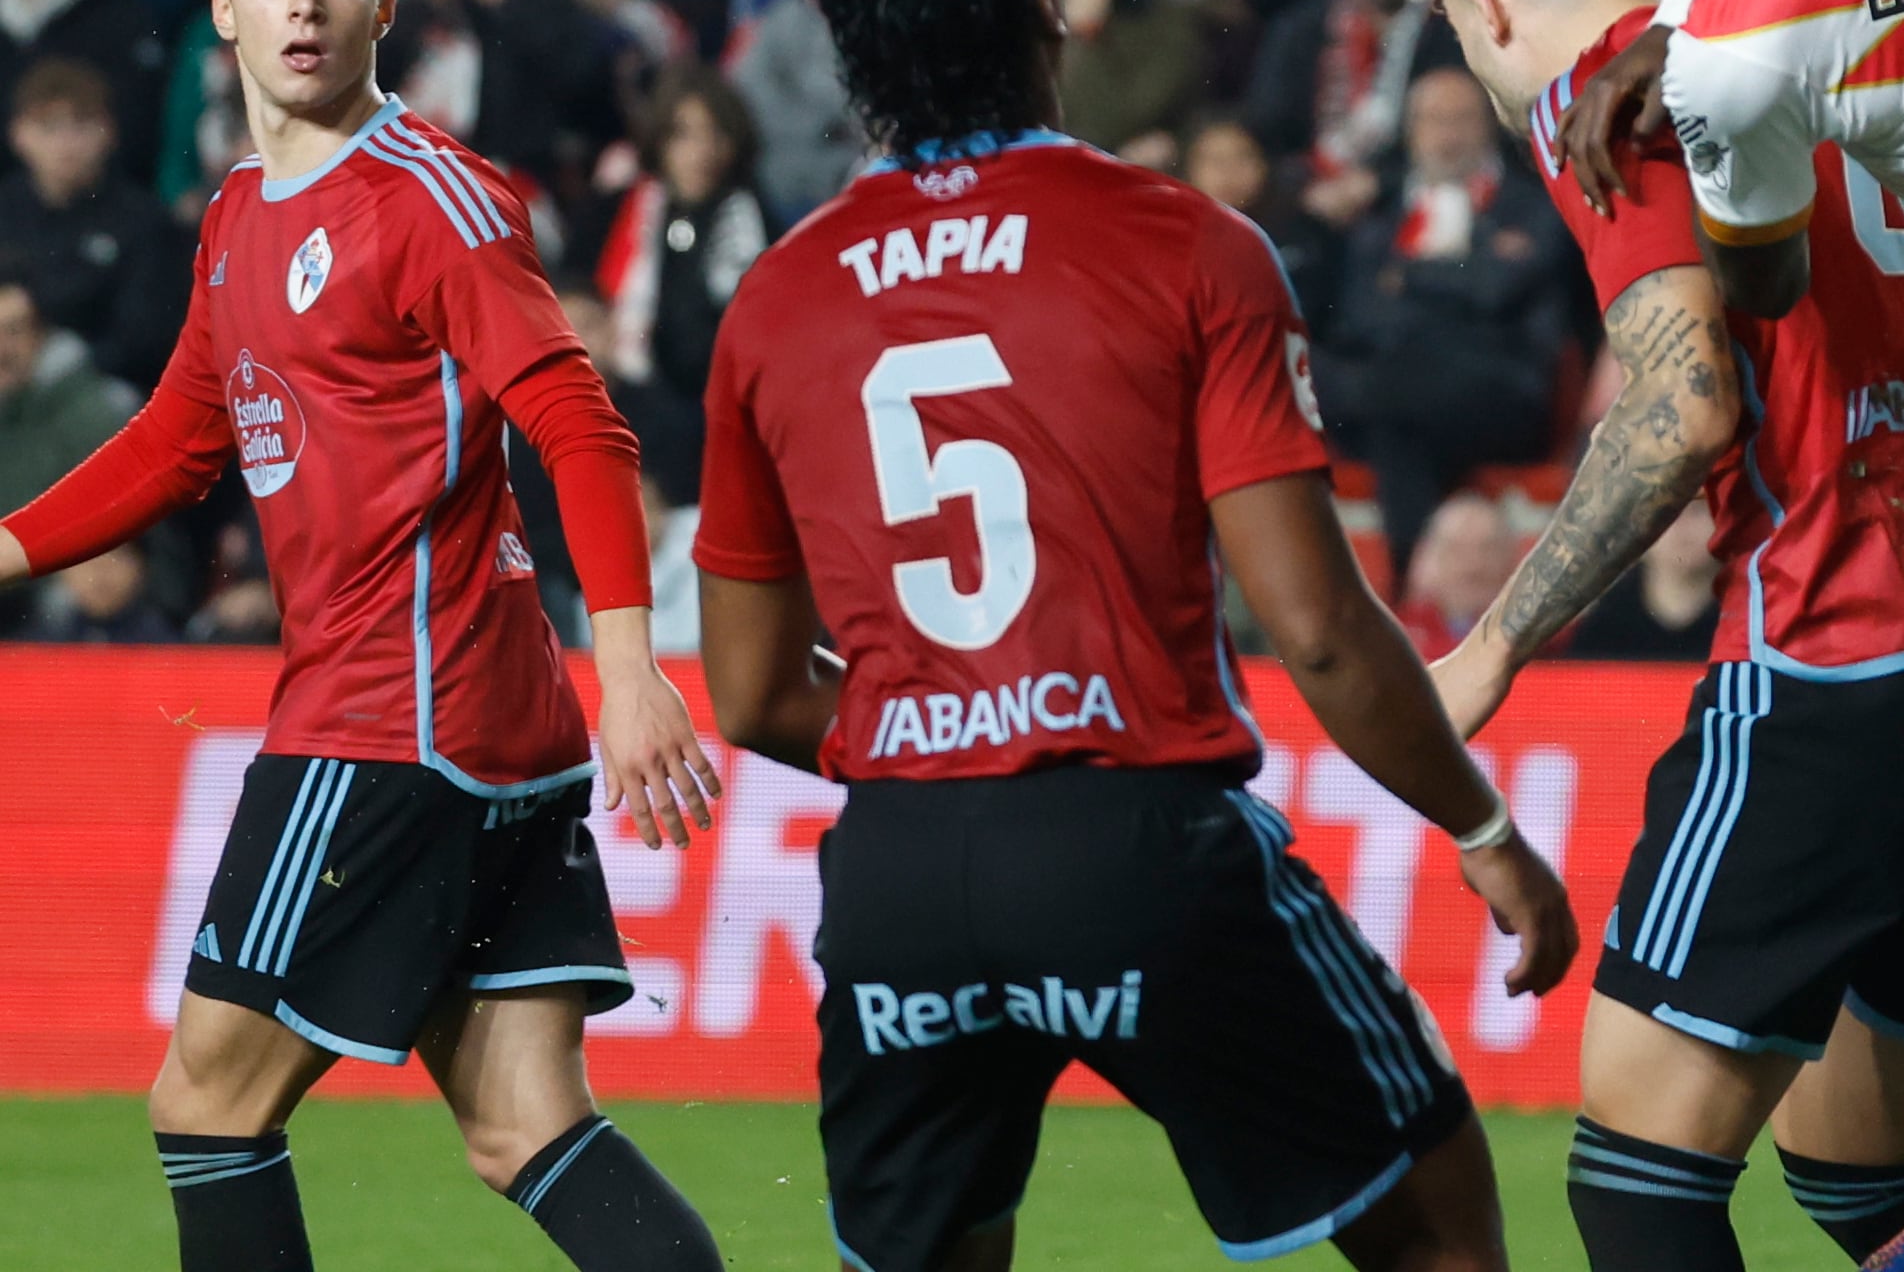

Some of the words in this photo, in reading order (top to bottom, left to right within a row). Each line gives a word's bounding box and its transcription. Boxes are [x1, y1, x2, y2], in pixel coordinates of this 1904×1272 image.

[838, 214, 1029, 297] TAPIA
[234, 393, 284, 428] Estrella
[241, 426, 284, 463] Galicia
[862, 333, 1036, 651] 5
[868, 671, 1125, 760] ABANCA
[852, 968, 1142, 1056] Recalvi
